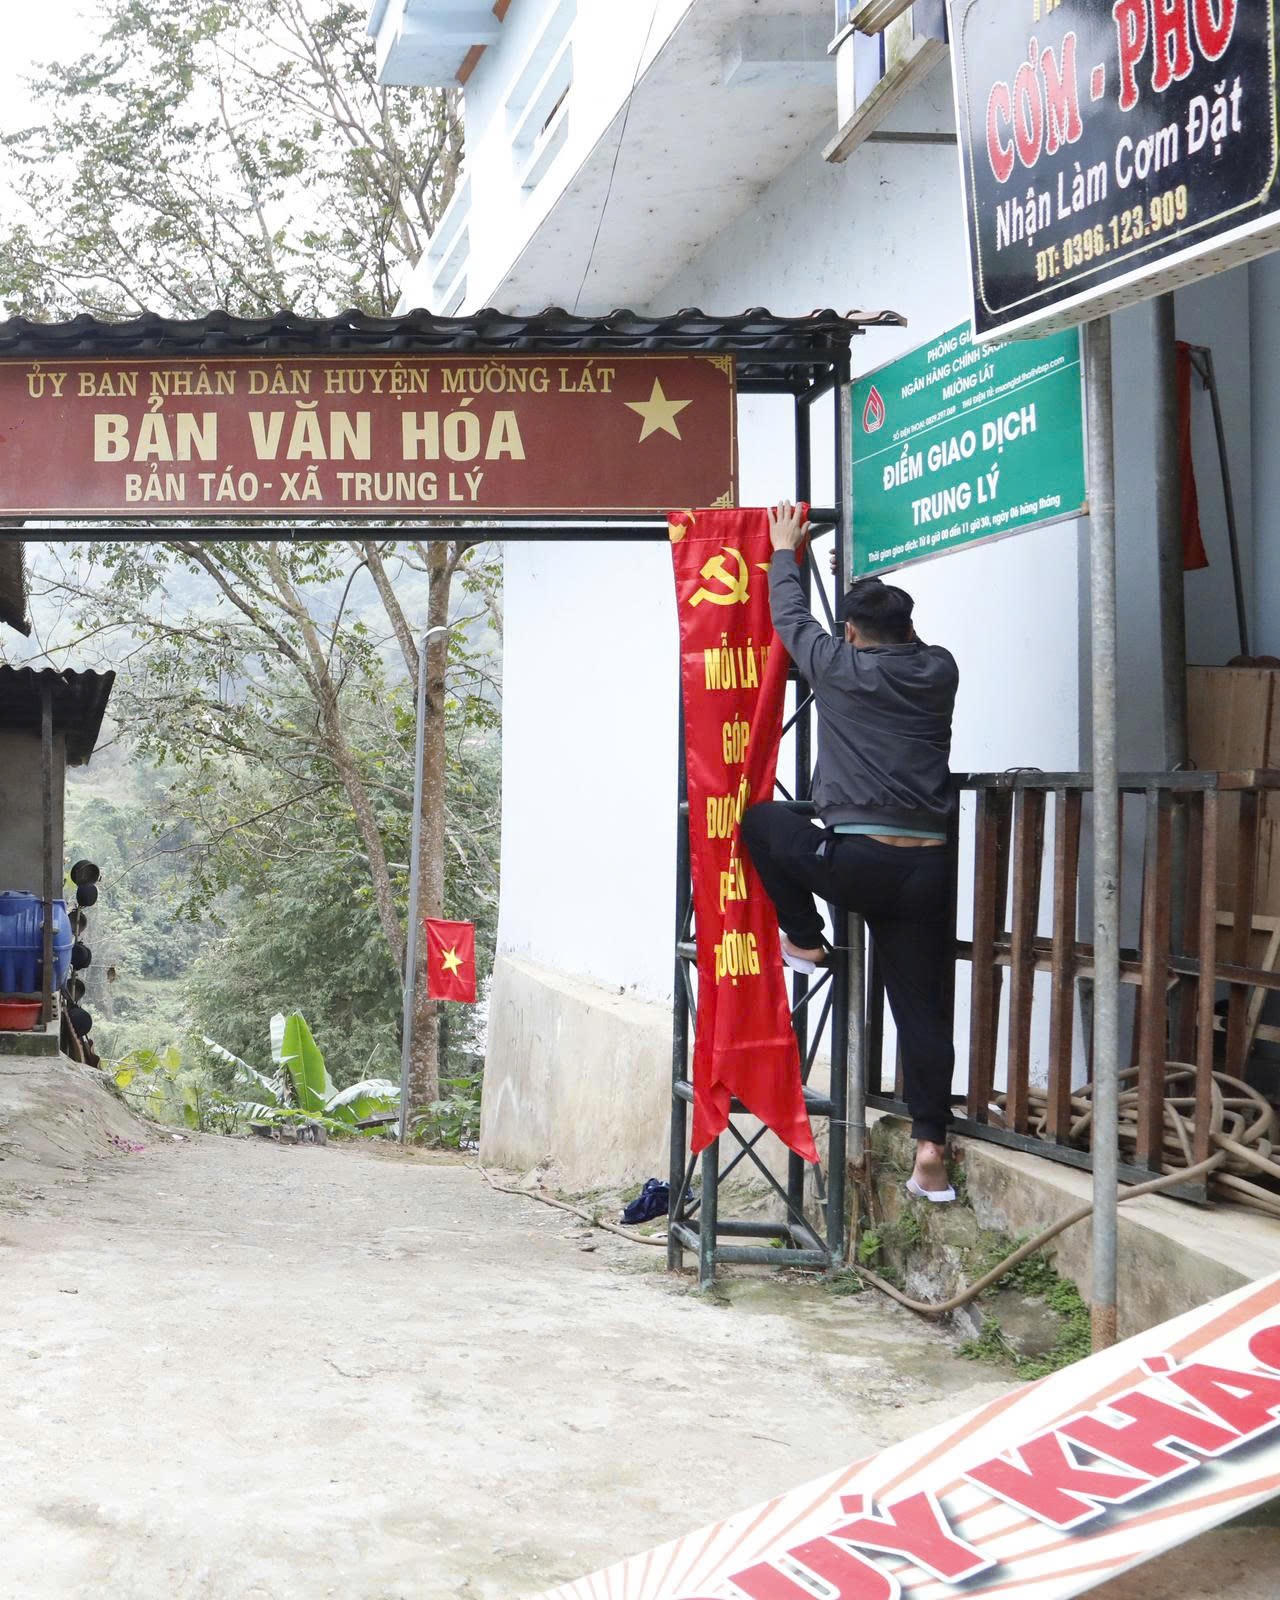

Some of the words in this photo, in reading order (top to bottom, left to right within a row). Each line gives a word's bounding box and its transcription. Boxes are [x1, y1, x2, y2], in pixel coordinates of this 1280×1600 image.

[996, 187, 1051, 251] Nhận
[1057, 161, 1108, 220] Làm
[1115, 122, 1178, 189] Cơm
[1185, 76, 1243, 156] Đặt
[1036, 245, 1061, 282] ĐT:
[1063, 184, 1188, 270] 0396.123.909
[27, 363, 68, 398] ỦY
[78, 371, 139, 397] BAN
[150, 364, 236, 396] NHÂN
[248, 363, 313, 395] DÂN
[325, 361, 429, 400] HUYỆN
[441, 360, 550, 394] MƯỜNG
[558, 360, 616, 393] LÁT
[901, 379, 925, 399] NGÂN
[926, 364, 951, 386] HÀNG
[952, 348, 980, 373] CHÍNH
[928, 337, 958, 363] PHÒNG
[979, 363, 995, 383] LÁT
[94, 396, 218, 462] BẢN
[248, 400, 371, 461] VĂN
[402, 397, 526, 461] HÓA
[883, 444, 923, 491] ĐIỂM
[927, 432, 976, 472] GIAO
[982, 403, 1036, 453] DỊCH
[125, 462, 186, 501] BẢN
[336, 472, 438, 501] TRUNG
[449, 466, 484, 501] LÝ
[912, 484, 971, 526] TRUNG
[977, 462, 1000, 504] LÝ
[880, 549, 892, 562] gian
[950, 523, 961, 539] đến
[962, 522, 969, 533] 11
[992, 510, 1009, 526] ngày
[1010, 507, 1019, 518] 06
[1019, 501, 1038, 518] hàng
[1039, 493, 1061, 510] tháng
[704, 632, 737, 690] MỖI
[737, 637, 759, 689] LÁ
[723, 712, 751, 765] GÓP
[676, 1492, 986, 1600] UÝ
